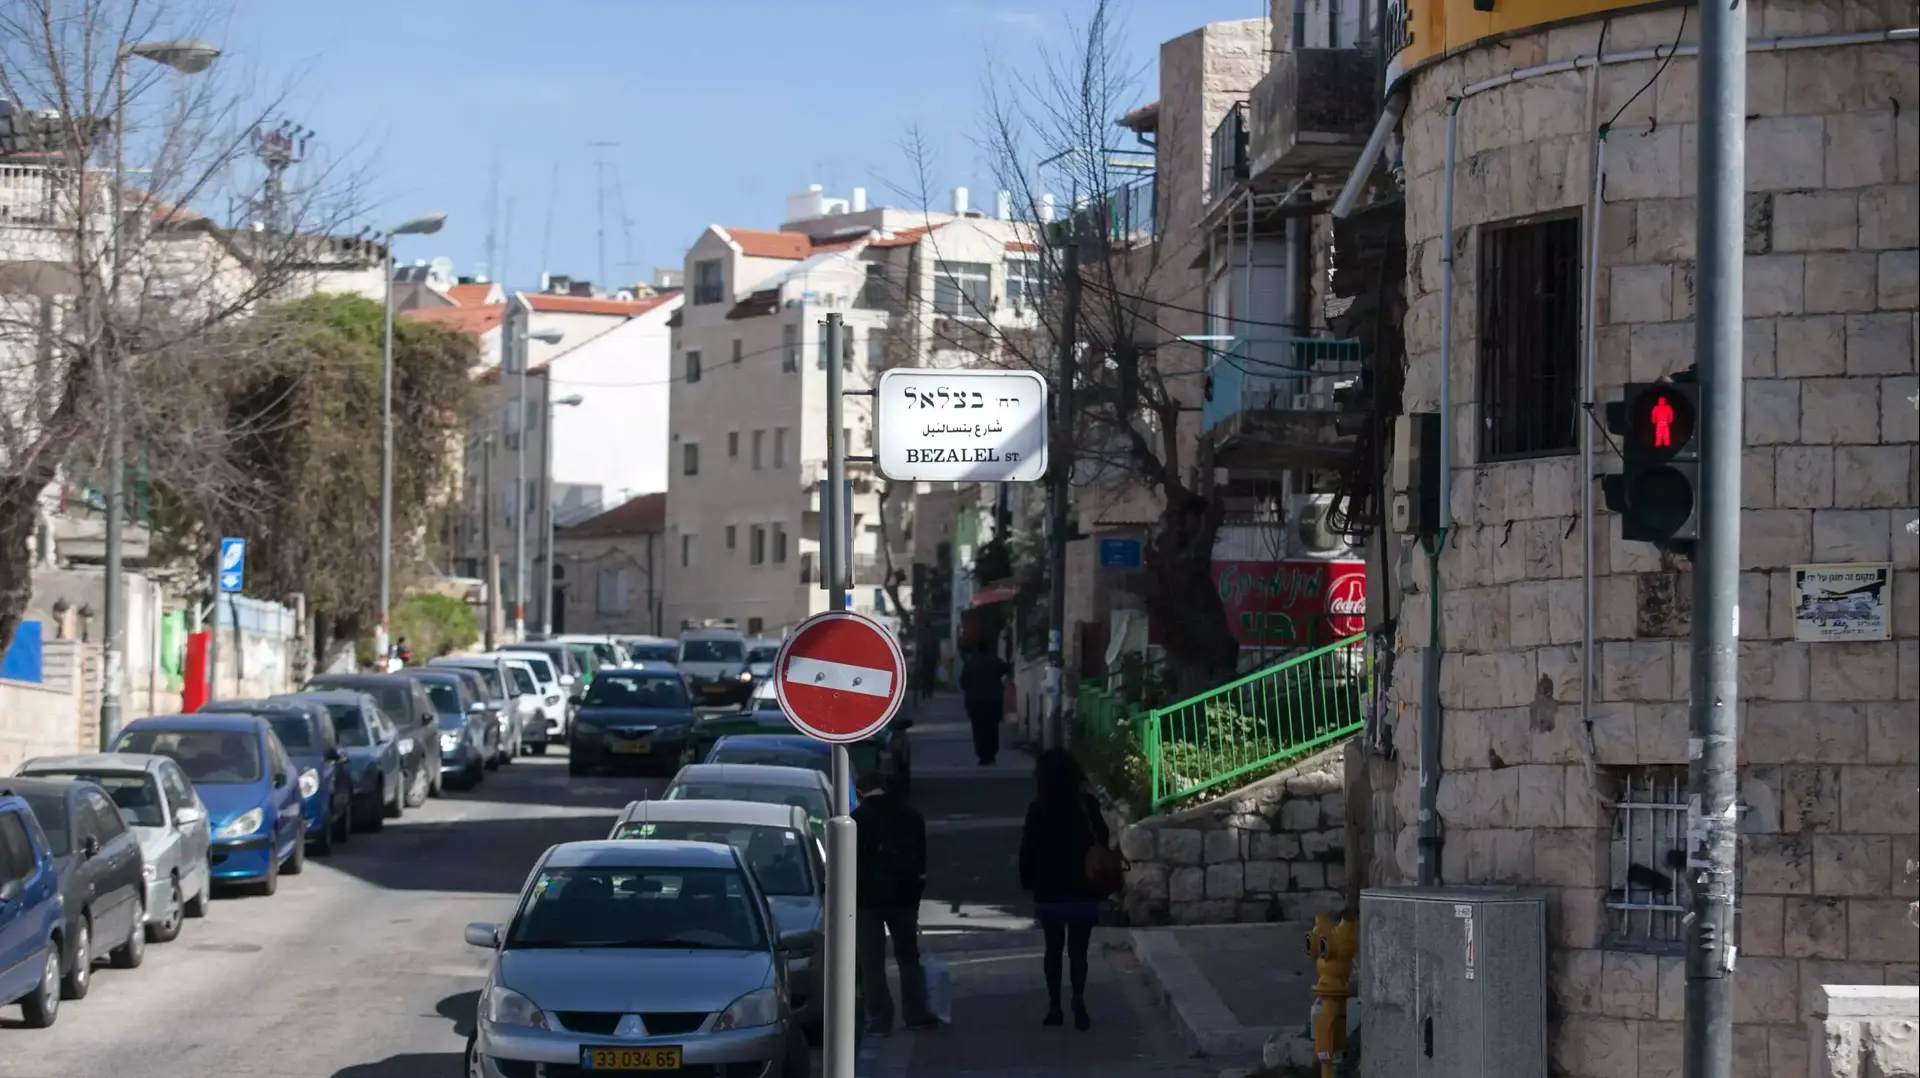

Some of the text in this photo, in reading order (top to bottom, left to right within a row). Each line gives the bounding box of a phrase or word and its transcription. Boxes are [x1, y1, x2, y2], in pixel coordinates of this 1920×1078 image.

[904, 386, 984, 409] בצלאל
[974, 420, 1003, 438] شارع
[906, 448, 1022, 463] BEZALEL ST.
[1855, 573, 1876, 583] מקום
[597, 1051, 676, 1067] 33 034 65
